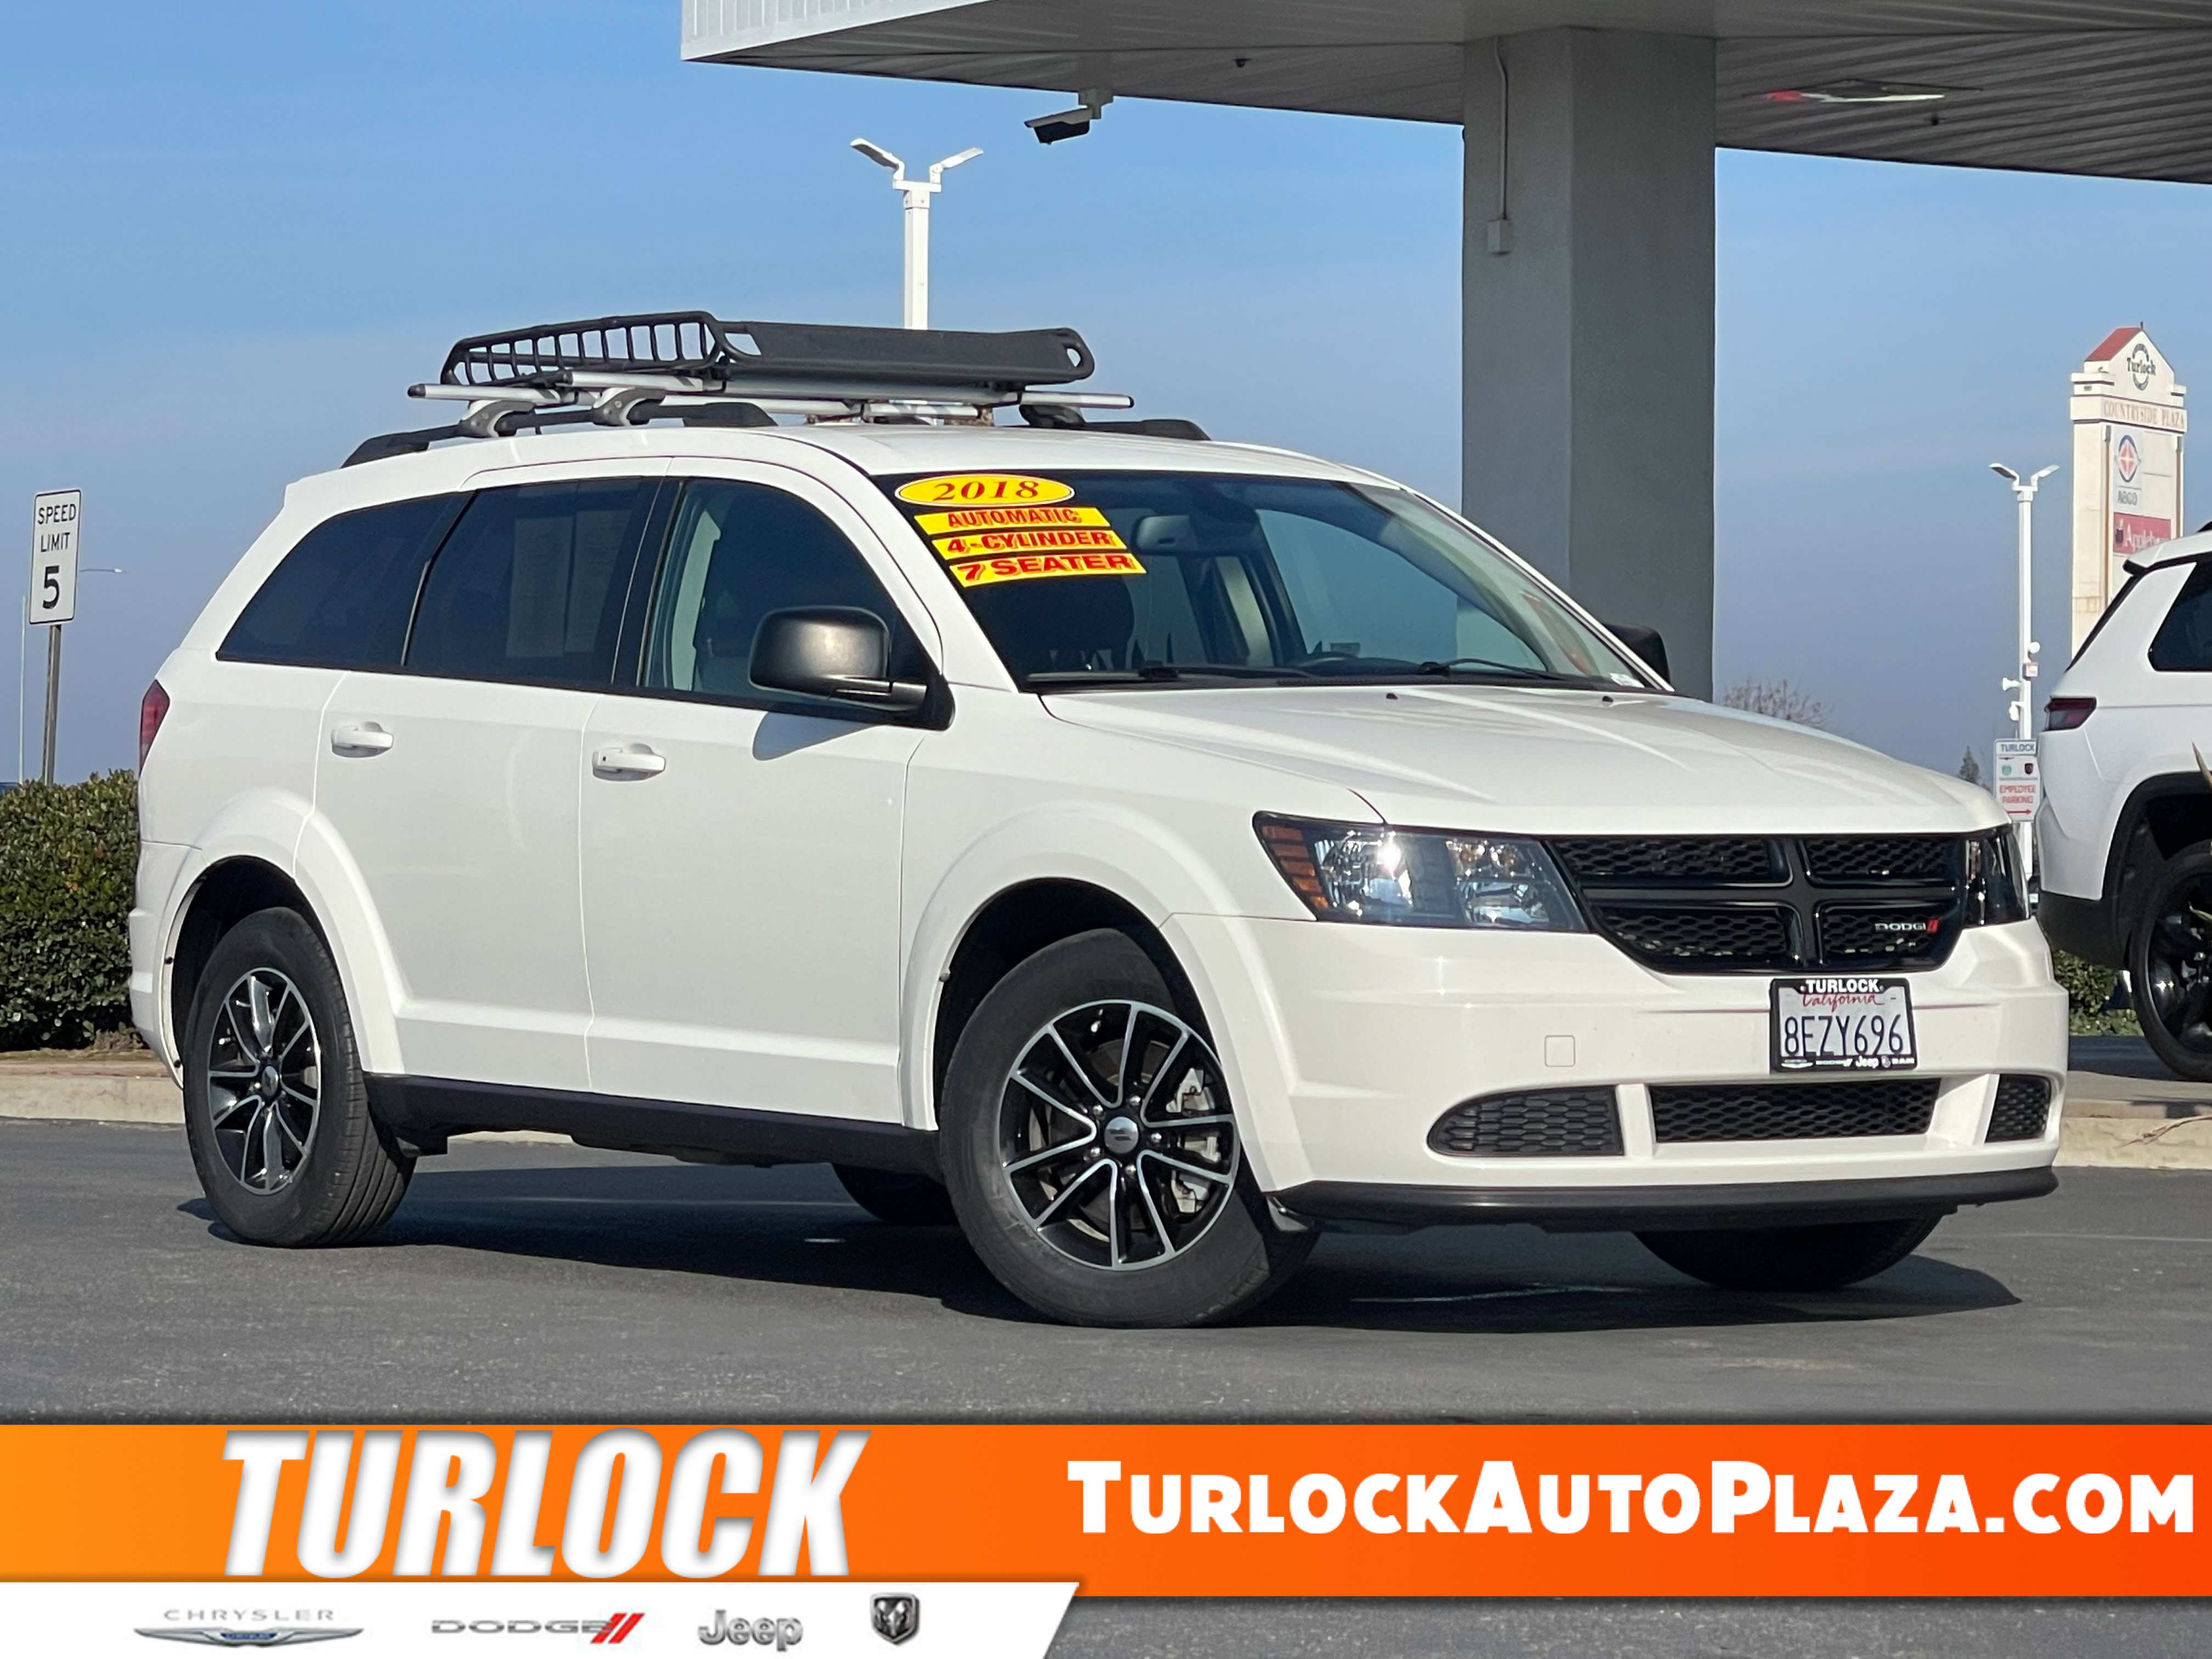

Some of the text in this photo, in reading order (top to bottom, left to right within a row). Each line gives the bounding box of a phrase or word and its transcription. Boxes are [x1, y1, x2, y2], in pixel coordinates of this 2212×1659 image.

[2127, 357, 2156, 376] Turlock
[2104, 400, 2185, 429] COUNTRYSIDE PLAZA
[932, 480, 1039, 501] 2018
[37, 503, 77, 525] SPEED
[947, 508, 1081, 528] AUTOMATIC
[41, 532, 71, 552] LIMIT
[947, 529, 1113, 554] 4-CYLINDER
[957, 554, 1136, 582] 7 SEATER
[42, 565, 60, 610] 5
[2001, 743, 2035, 752] TURLOCK
[1999, 785, 2036, 794] EMPLOYEE
[2001, 795, 2034, 804] PARKING
[1805, 979, 1880, 994] TURLOCK
[1802, 993, 1885, 1013] California
[1785, 1014, 1904, 1057] 8EZY696
[1855, 1056, 1880, 1069] Jeep
